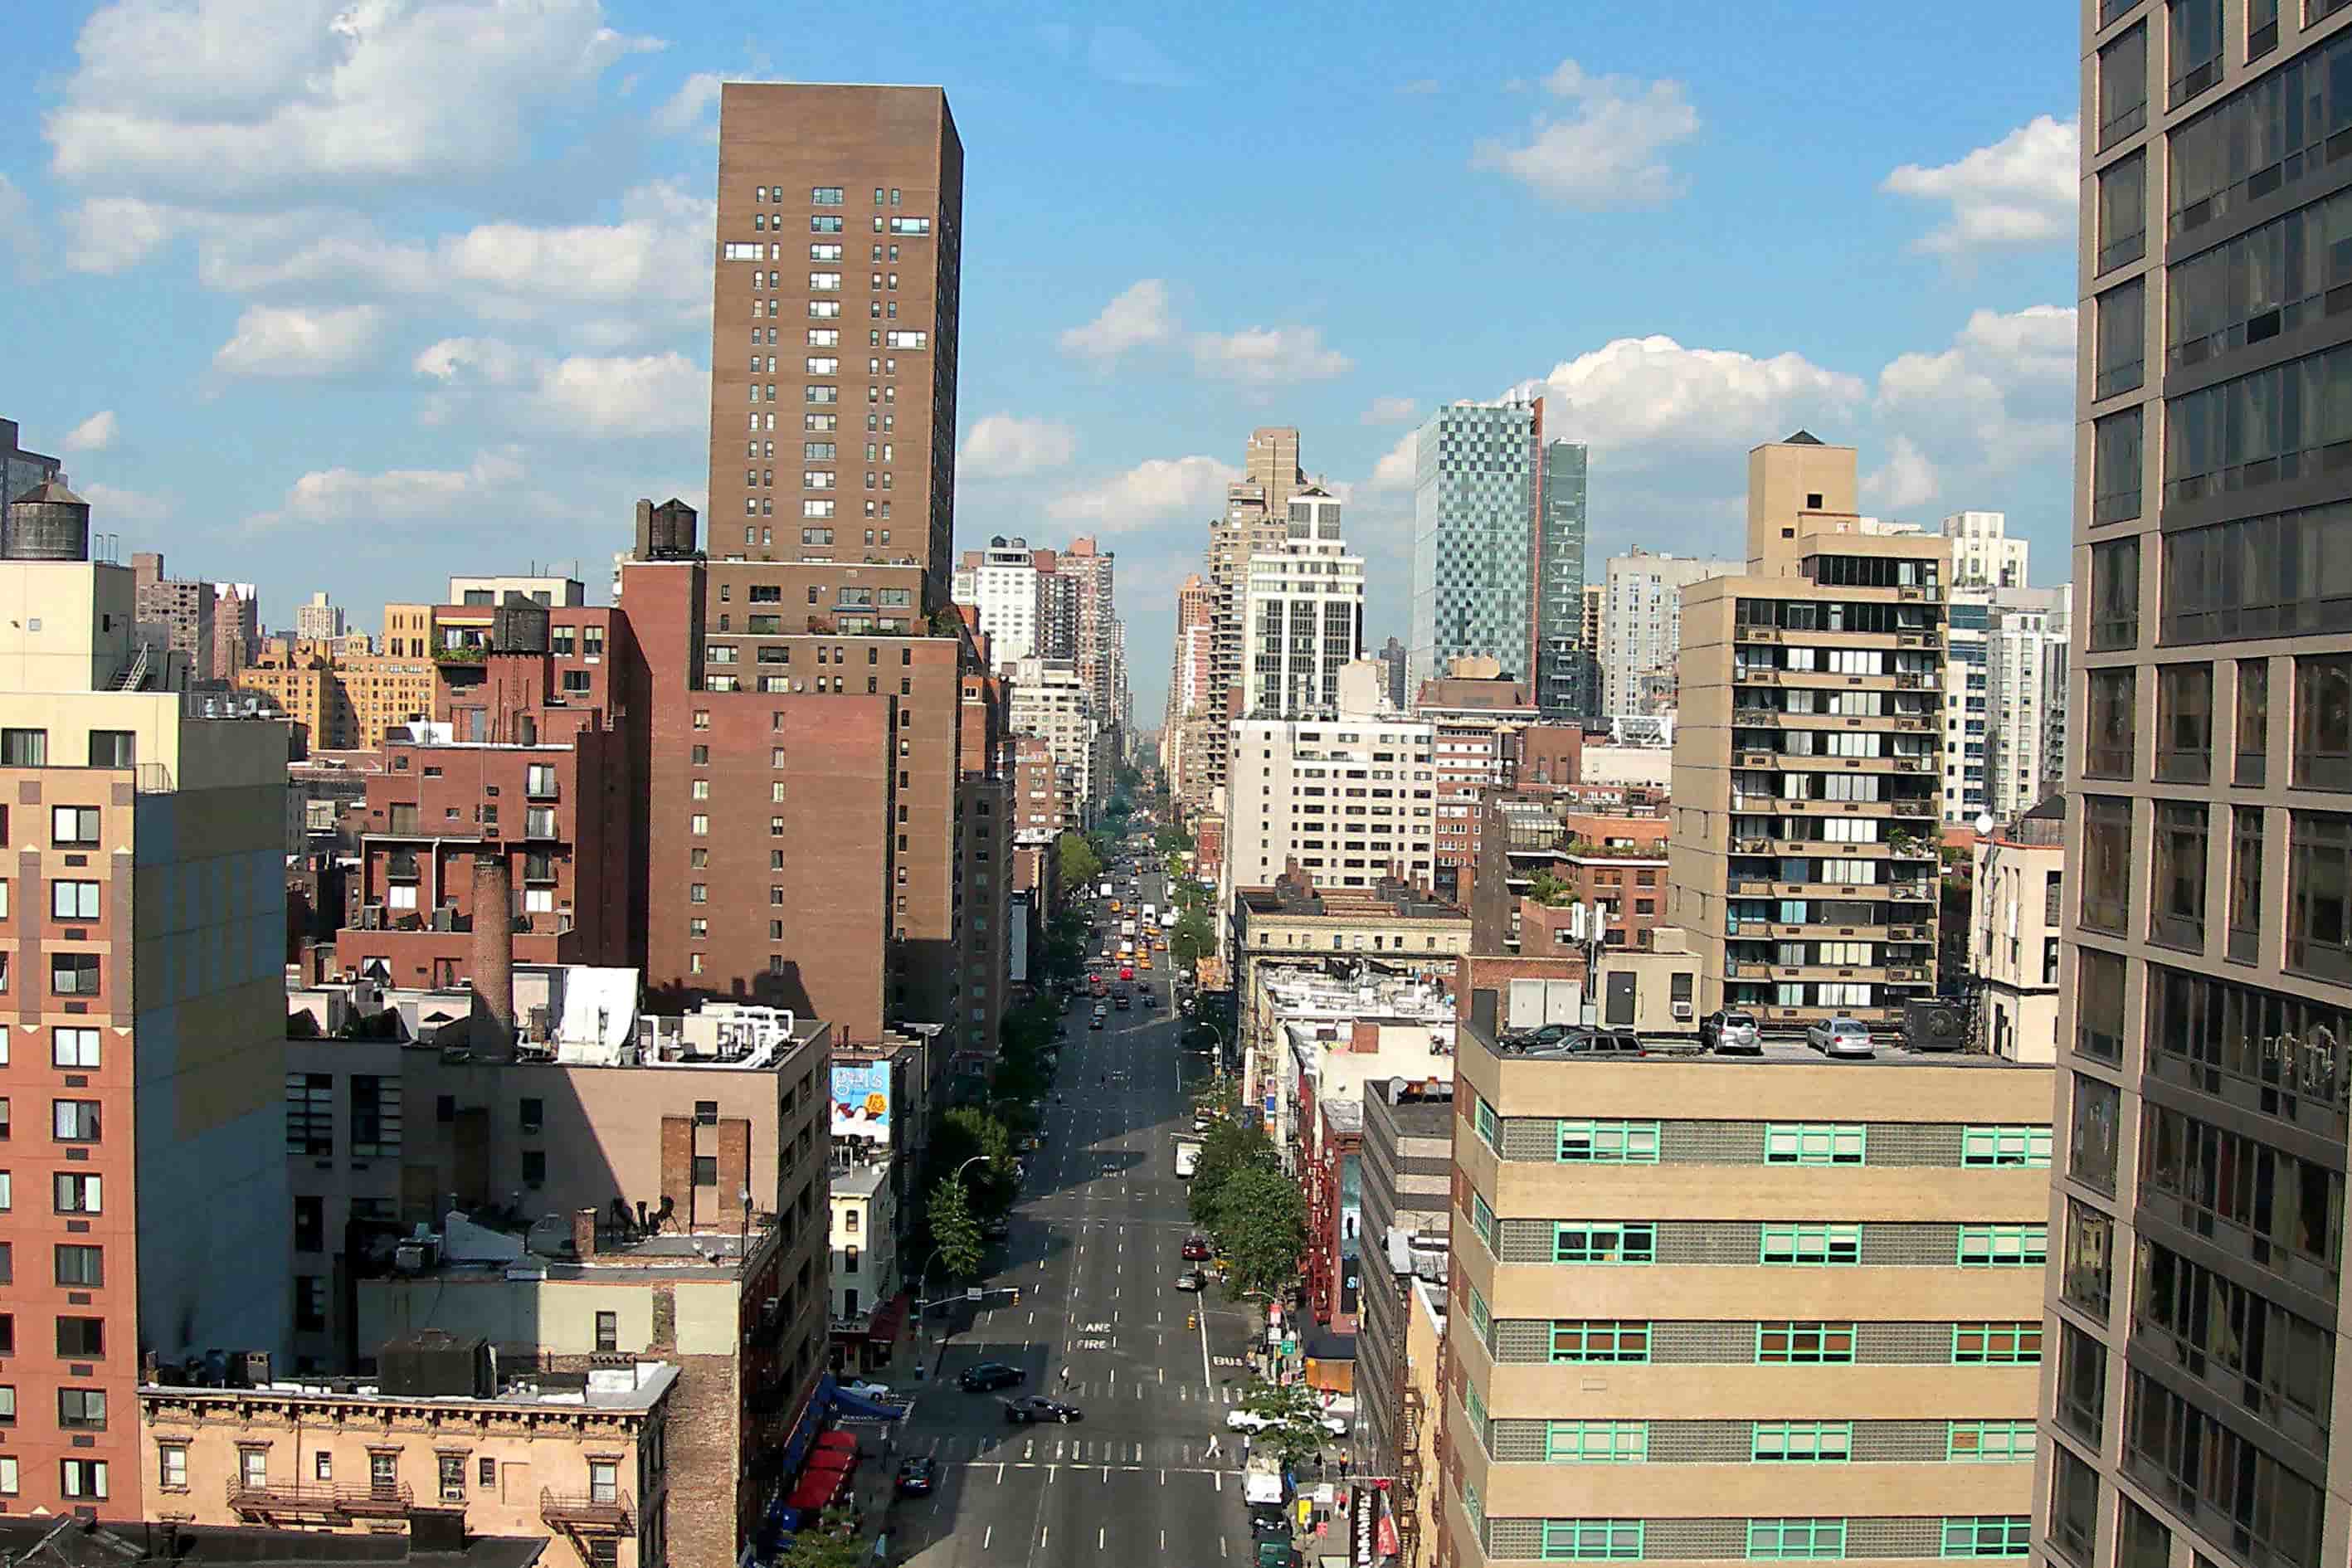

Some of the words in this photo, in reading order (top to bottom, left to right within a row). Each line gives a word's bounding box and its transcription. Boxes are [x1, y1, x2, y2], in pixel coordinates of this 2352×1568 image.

[1077, 1322, 1111, 1332] LANE
[1076, 1339, 1107, 1349] FIRE
[1213, 1356, 1243, 1367] BUS
